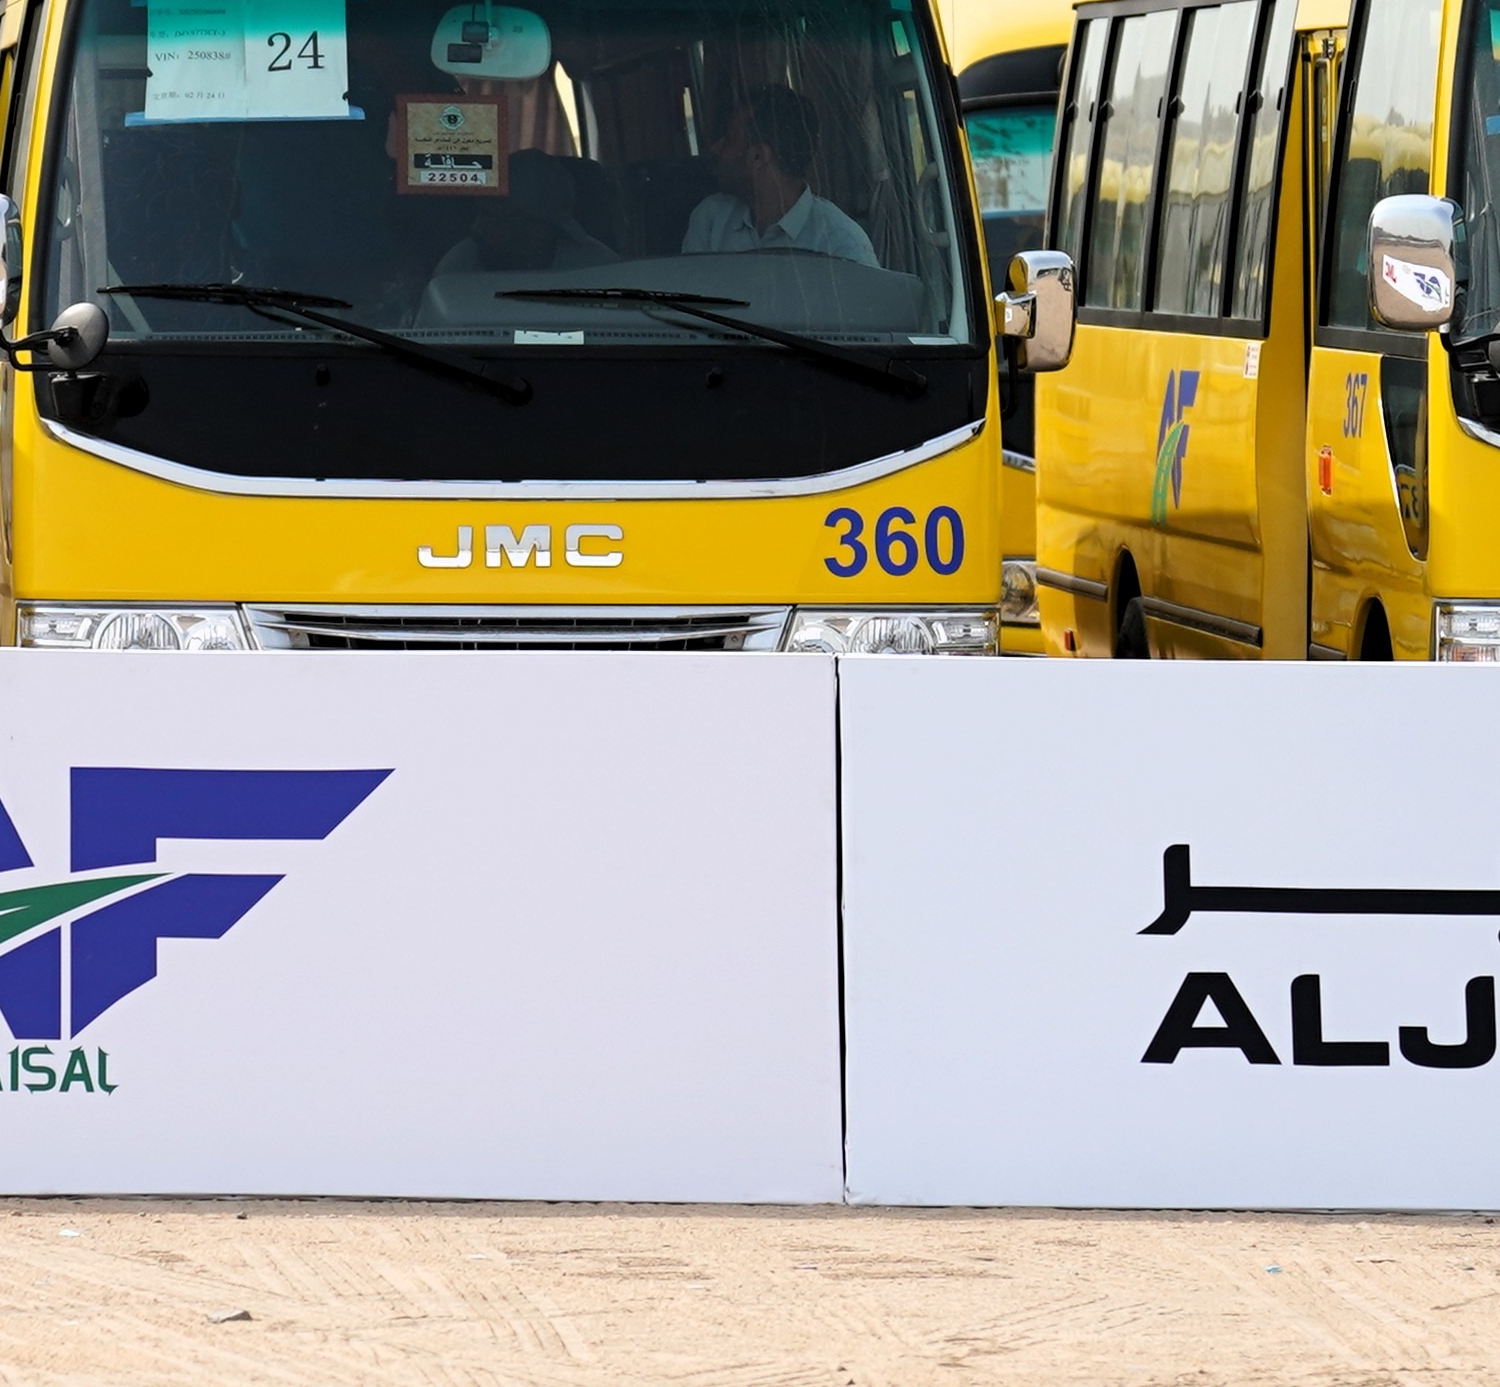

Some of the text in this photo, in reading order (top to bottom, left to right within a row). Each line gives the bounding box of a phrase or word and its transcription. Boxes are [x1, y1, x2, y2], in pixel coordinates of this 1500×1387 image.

[267, 30, 325, 72] 24
[428, 172, 478, 182] 22504
[1343, 372, 1368, 438] 367
[417, 524, 623, 568] JMC
[824, 506, 965, 577] 360
